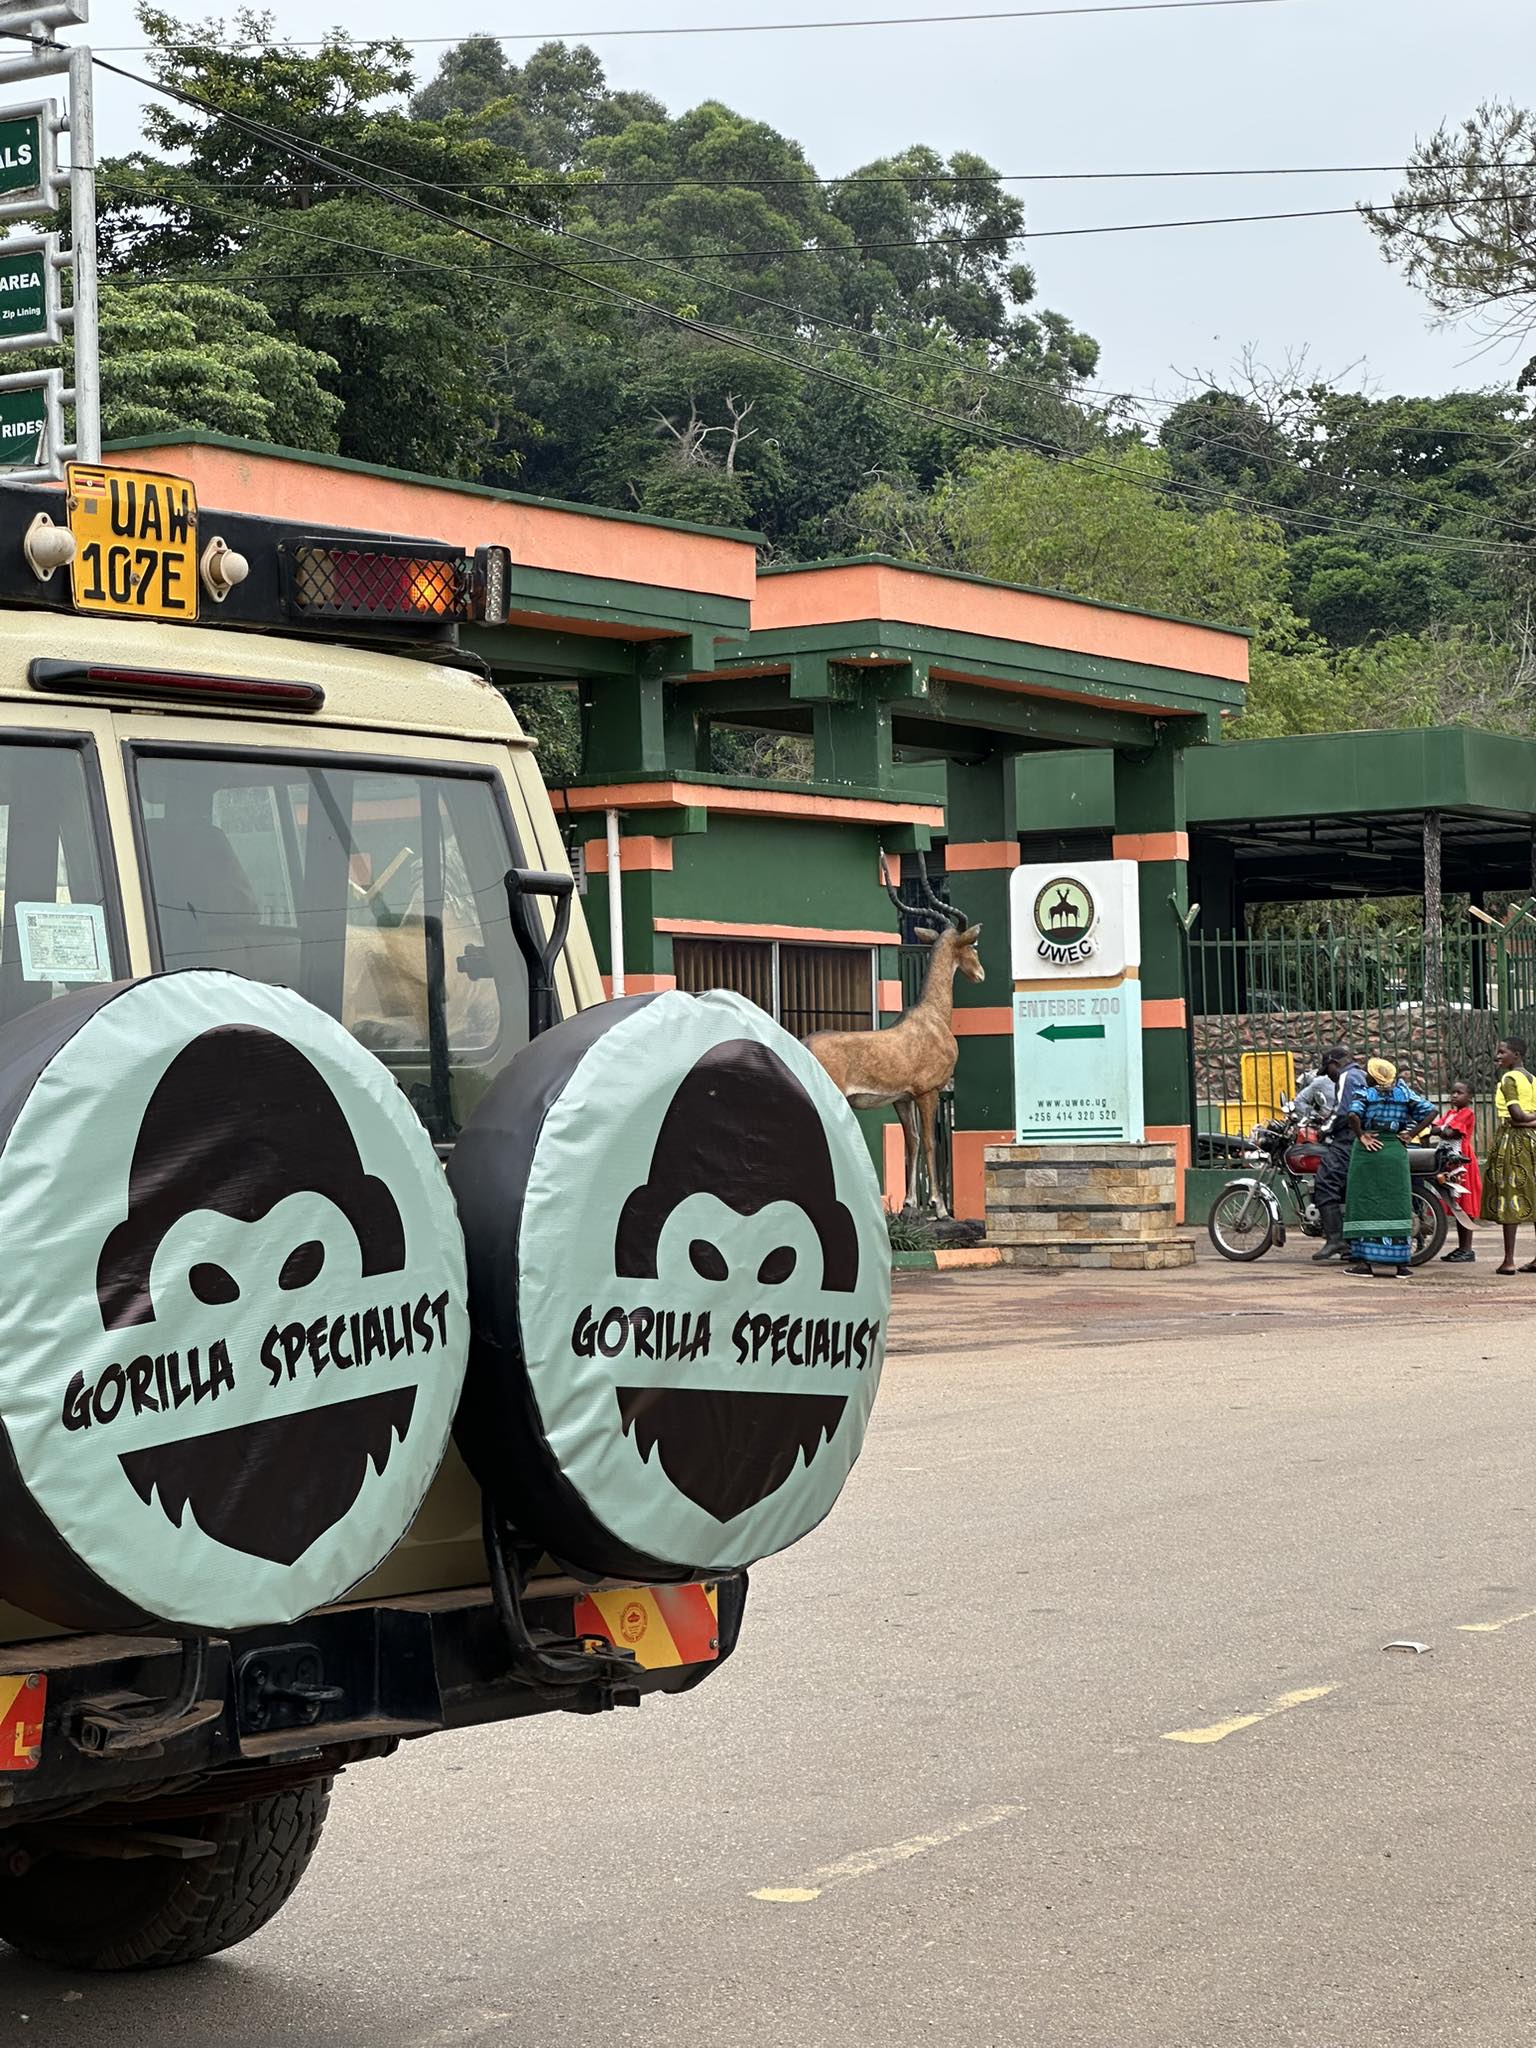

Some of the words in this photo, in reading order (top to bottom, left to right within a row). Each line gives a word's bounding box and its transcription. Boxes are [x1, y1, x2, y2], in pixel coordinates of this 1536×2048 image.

[2, 310, 16, 319] Zip
[16, 307, 41, 317] Lining
[2, 420, 44, 438] RIDES
[110, 479, 189, 544] UAW
[82, 542, 186, 609] 107E
[1037, 940, 1092, 962] UWEC
[1018, 999, 1086, 1018] ENTEBBE
[1091, 997, 1120, 1015] ZOO
[1037, 1098, 1107, 1108] www.uwec.ug
[1028, 1112, 1052, 1122] +256
[1056, 1111, 1073, 1121] 414
[1077, 1110, 1095, 1121] 320
[1099, 1109, 1117, 1120] 520
[571, 1304, 712, 1361] GORILLA
[731, 1309, 880, 1371] SPECIALIST
[61, 1337, 236, 1432] GORILLA
[259, 1289, 450, 1388] SPECIALIST
